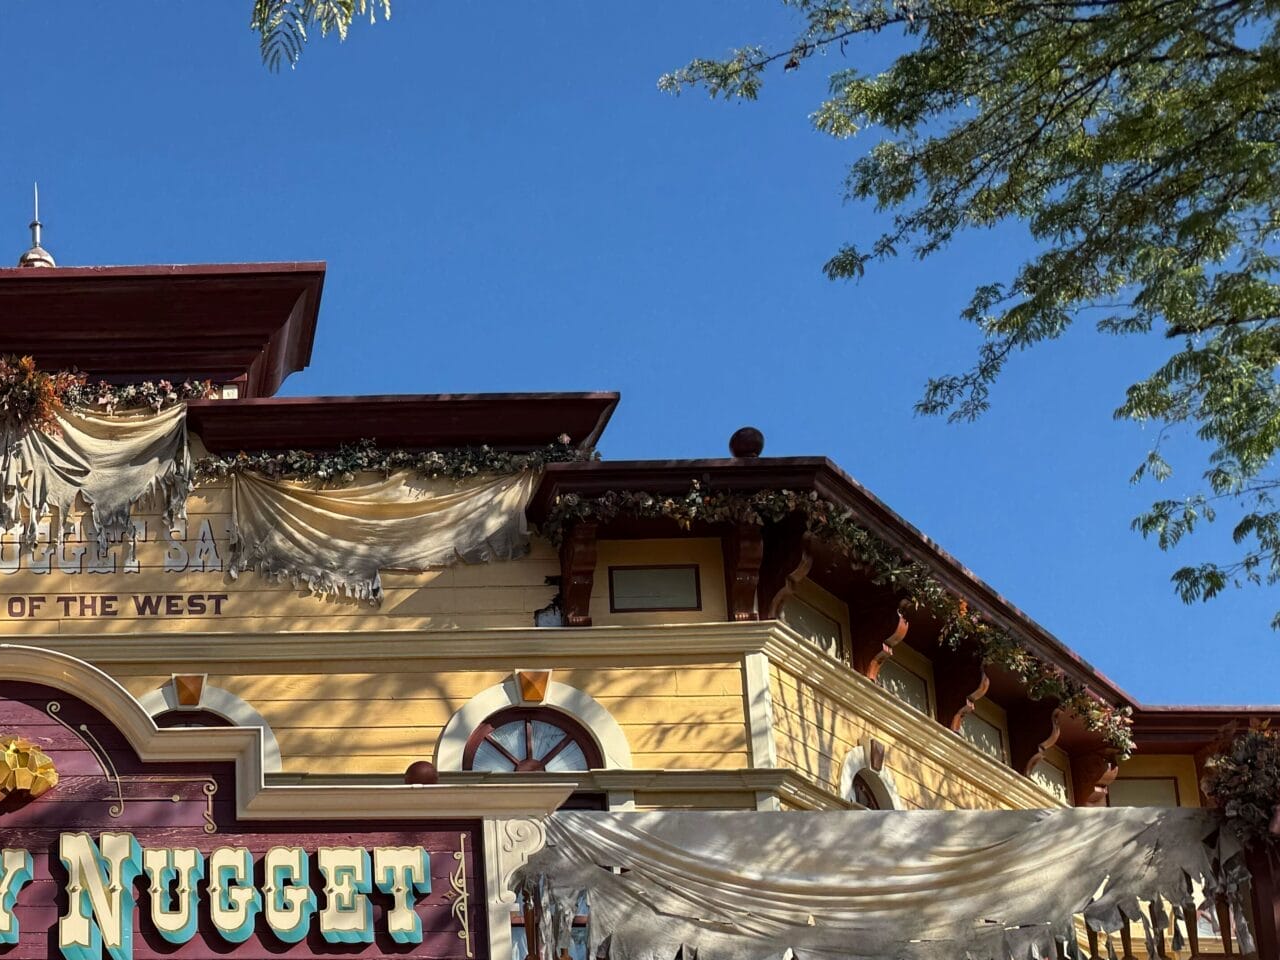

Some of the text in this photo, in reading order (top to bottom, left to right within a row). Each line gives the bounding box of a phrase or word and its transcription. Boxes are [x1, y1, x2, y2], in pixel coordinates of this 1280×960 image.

[7, 595, 46, 618] OF
[57, 595, 118, 617] THE
[132, 594, 229, 616] WEST
